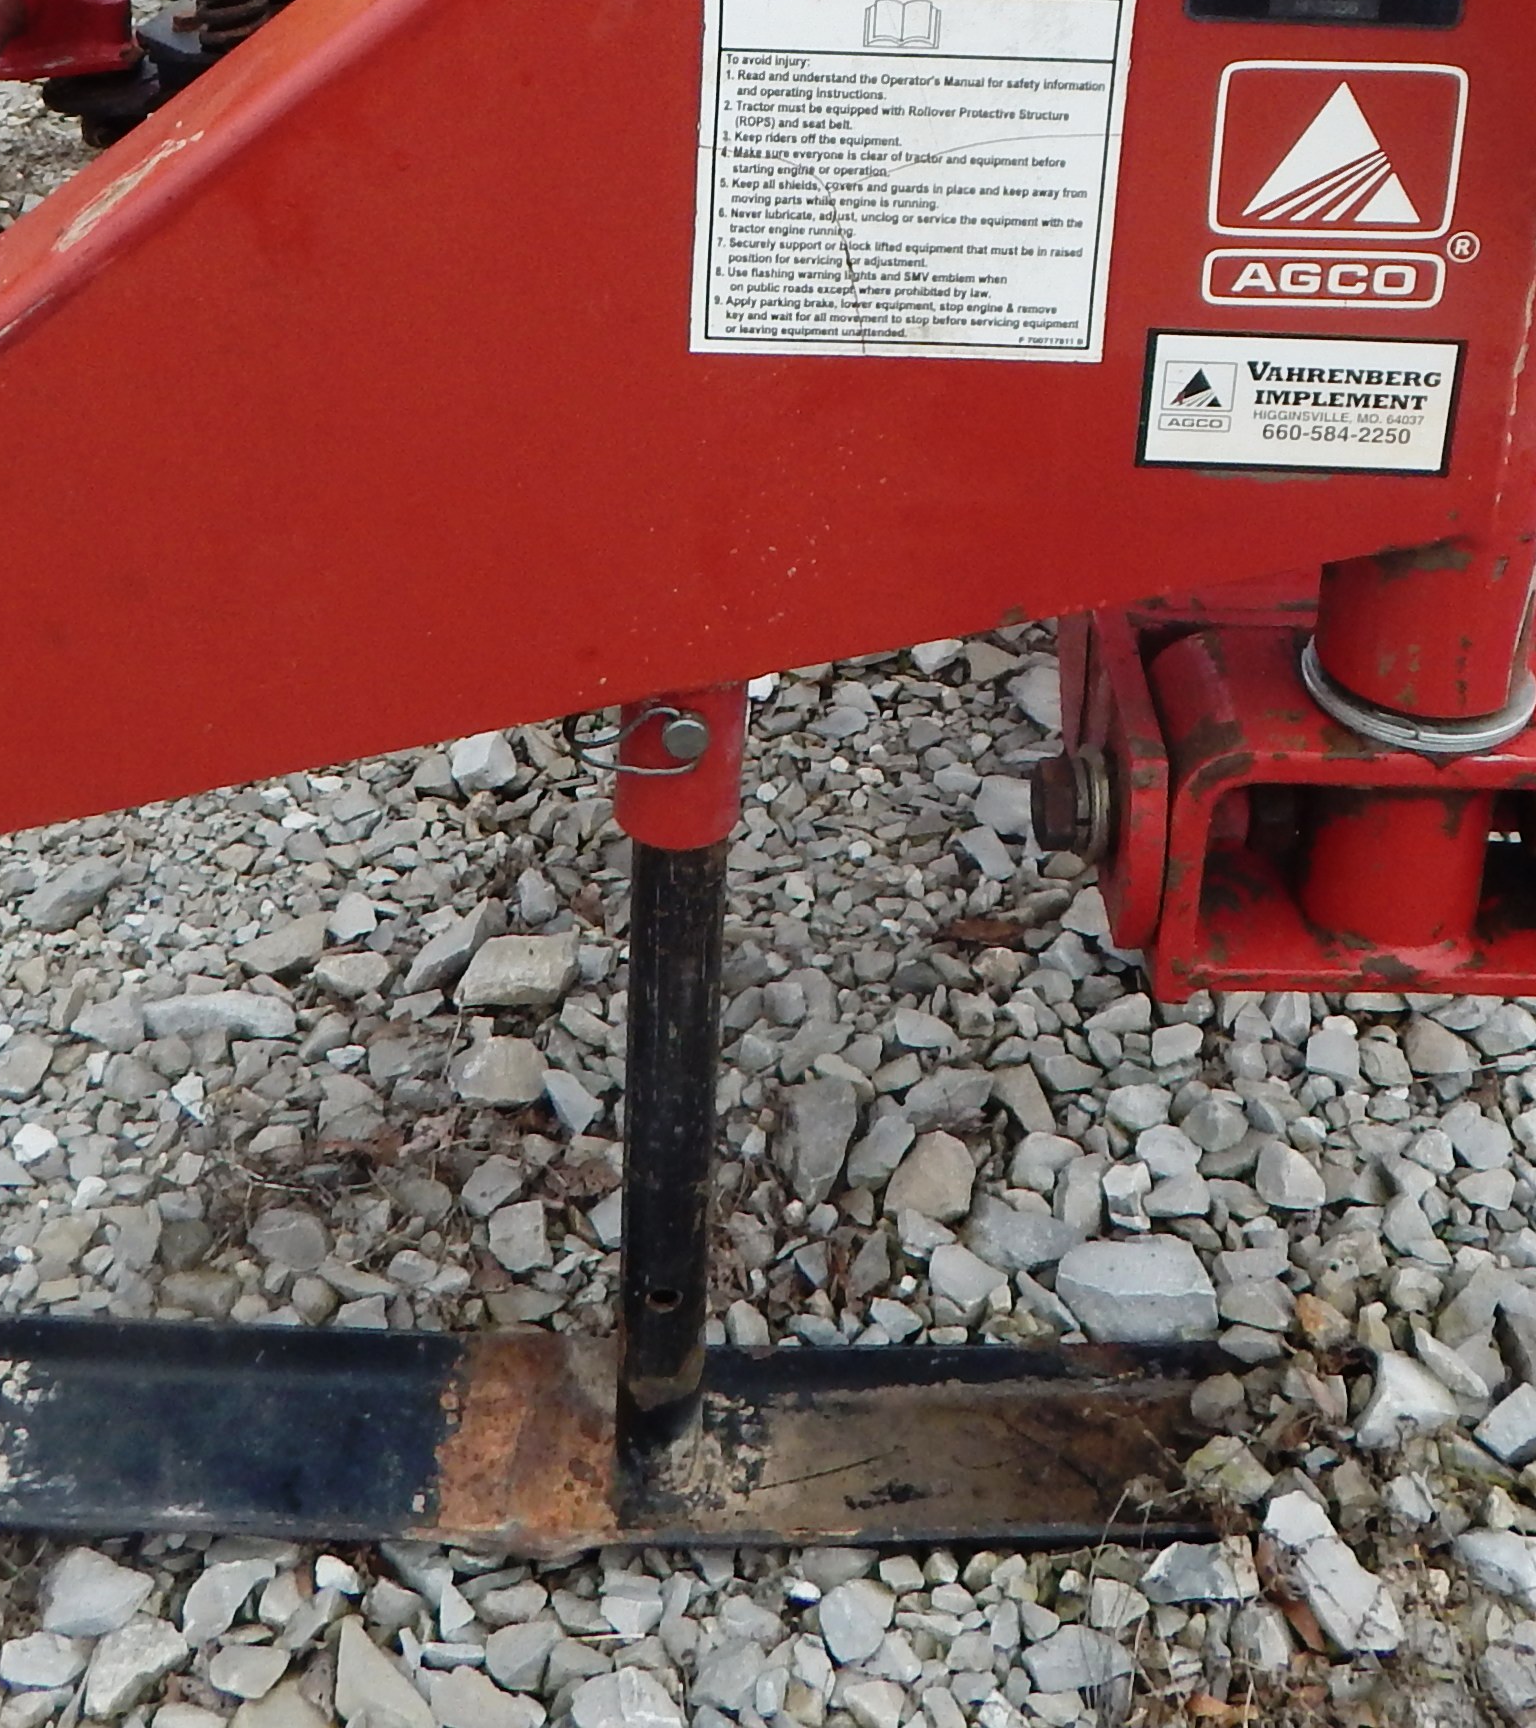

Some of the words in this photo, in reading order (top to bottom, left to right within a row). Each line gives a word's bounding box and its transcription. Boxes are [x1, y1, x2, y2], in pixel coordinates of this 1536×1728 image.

[726, 54, 739, 64] To
[741, 55, 772, 65] avoid
[774, 56, 810, 68] injury:
[736, 70, 766, 81] Read
[767, 71, 790, 81] and
[792, 72, 857, 83] understand
[858, 74, 878, 84] the
[879, 75, 941, 88] Operator's
[943, 77, 985, 87] Manual
[986, 78, 1004, 88] for
[1005, 79, 1040, 91] safety
[1042, 80, 1106, 91] information
[736, 86, 757, 96] and
[759, 86, 813, 99] operating
[815, 88, 887, 100] instructions.
[735, 101, 775, 112] Tractor
[777, 102, 806, 113] must
[808, 103, 823, 113] be
[825, 104, 879, 117] equipped
[880, 106, 906, 116] with
[907, 106, 957, 117] Rollover
[958, 108, 1016, 119] Protective
[1018, 110, 1070, 121] Structure
[734, 117, 775, 129] (ROPS)
[777, 118, 799, 128] and
[801, 119, 826, 129] seat
[828, 120, 853, 130] belt.
[733, 132, 762, 144] Keep
[764, 133, 798, 143] riders
[800, 134, 816, 144] off
[818, 134, 836, 144] the
[838, 135, 903, 148] equipment.
[792, 150, 844, 162] everyone
[846, 151, 857, 160] is
[859, 151, 888, 161] clear
[889, 152, 903, 162] of
[903, 152, 943, 163] tractor
[945, 154, 968, 164] and
[968, 154, 1029, 167] equipment
[1030, 156, 1067, 167] before
[731, 163, 774, 175] starting
[818, 167, 830, 175] or
[731, 178, 760, 190] Keep
[762, 179, 775, 189] all
[866, 182, 888, 192] and
[889, 183, 930, 195] guards
[932, 184, 944, 194] in
[945, 185, 976, 197] place
[978, 186, 1000, 196] and
[1001, 186, 1030, 198] keep
[1031, 189, 1060, 199] away
[1061, 188, 1088, 198] from
[730, 193, 771, 205] moving
[773, 194, 802, 206] parts
[839, 196, 877, 208] engine
[879, 197, 890, 207] is
[892, 198, 939, 210] running.
[730, 208, 762, 218] Never
[860, 212, 899, 224] unclog
[901, 215, 914, 223] or
[916, 214, 957, 224] service
[959, 215, 978, 225] the
[979, 216, 1039, 229] equipment
[1040, 218, 1064, 228] with
[1065, 218, 1084, 228] the
[729, 223, 765, 234] tractor
[767, 224, 805, 236] engine
[728, 238, 776, 250] Securely
[778, 239, 822, 251] support
[824, 242, 836, 250] or
[874, 242, 903, 252] lifted
[904, 243, 964, 256] equipment
[965, 245, 988, 255] that
[989, 246, 1019, 256] must
[1020, 247, 1035, 256] be
[1036, 247, 1048, 256] in
[1049, 247, 1083, 258] raised
[727, 253, 772, 265] position
[774, 254, 791, 264] for
[793, 255, 843, 267] servicing
[863, 257, 928, 269] adjustment.
[726, 267, 748, 277] Use
[750, 268, 795, 280] flashing
[797, 269, 841, 281] warning
[879, 272, 901, 281] and
[903, 272, 929, 282] SMV
[930, 273, 976, 284] emblem
[977, 275, 1008, 285] when
[1231, 262, 1417, 296] AGCO
[729, 283, 744, 291] on
[746, 282, 780, 294] public
[782, 283, 814, 293] roads
[858, 285, 891, 295] where
[893, 287, 951, 299] prohibited
[952, 288, 967, 299] by
[969, 289, 992, 298] law.
[725, 296, 757, 308] Apply
[759, 297, 801, 309] parking
[938, 302, 964, 314] stop
[965, 303, 1004, 315] engine
[1005, 304, 1015, 313] &
[1016, 306, 1058, 315] remove
[725, 310, 744, 321] key
[746, 311, 768, 320] and
[770, 312, 793, 321] wait
[794, 312, 811, 322] for
[813, 313, 827, 322] all
[890, 315, 902, 324] to
[904, 316, 930, 327] stop
[931, 316, 968, 326] before
[969, 317, 1020, 329] servicing
[1021, 319, 1079, 331] equipment
[724, 325, 736, 333] or
[739, 324, 777, 336] leaving
[780, 326, 838, 338] equipment
[1247, 361, 1442, 388] VAHRENBERG
[1254, 389, 1428, 411] IMPLEMENT
[1167, 417, 1223, 430] AGCO
[1252, 410, 1353, 425] HIGGINSVILLE,
[1386, 414, 1425, 426] 64037
[1262, 424, 1412, 445] 660-584-2250
